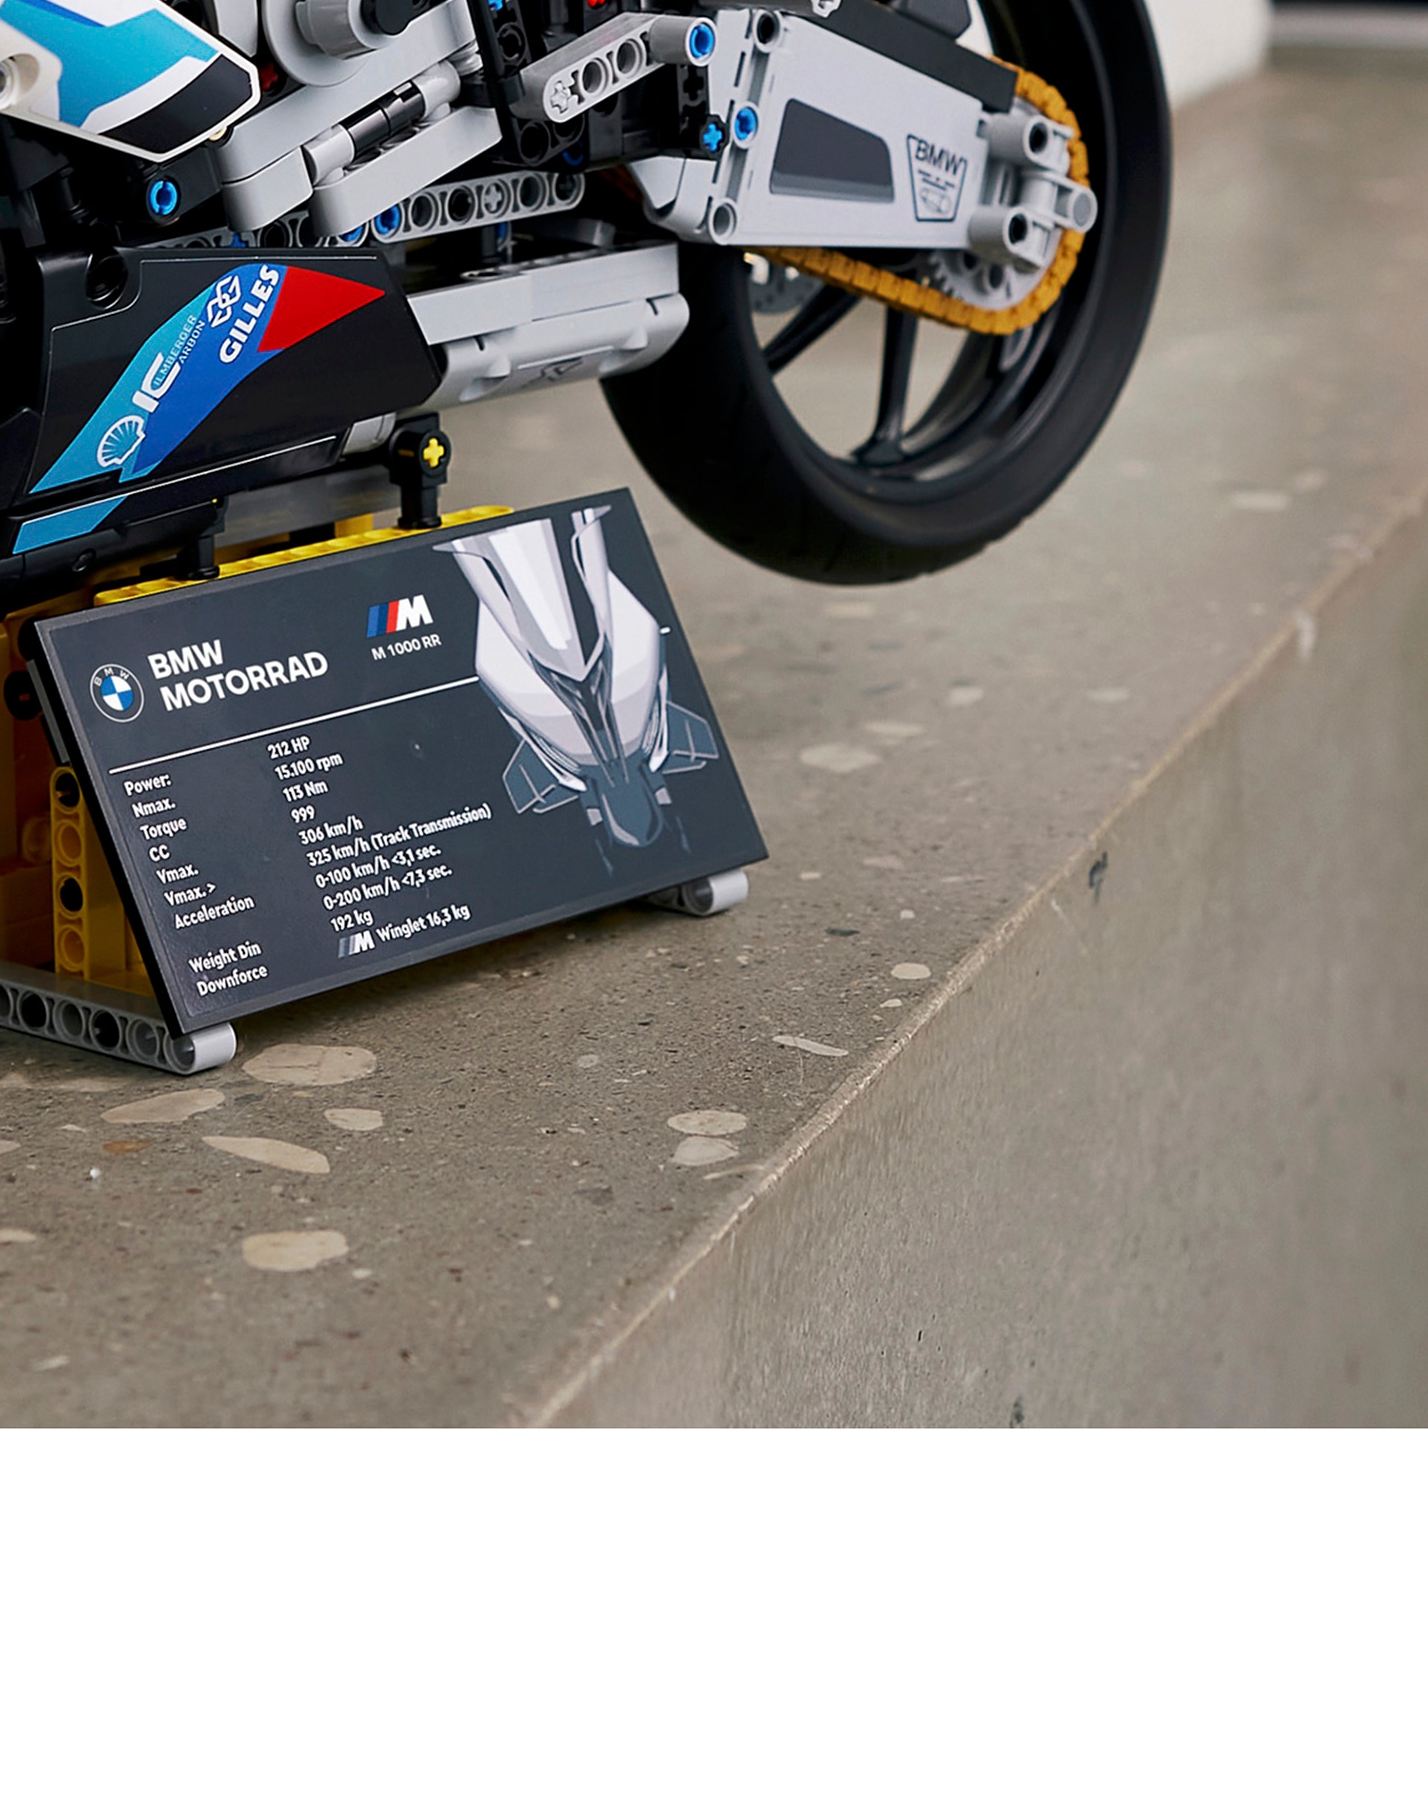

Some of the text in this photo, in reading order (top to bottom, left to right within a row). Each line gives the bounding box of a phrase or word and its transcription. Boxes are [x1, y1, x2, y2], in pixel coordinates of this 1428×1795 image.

[915, 140, 967, 176] BMW
[219, 264, 280, 363] GILLES
[153, 314, 197, 386] ILMBERGER
[147, 639, 225, 680] BMW
[371, 633, 442, 661] M 1000 RR
[159, 651, 329, 713] MOTORRAD
[267, 735, 311, 760] 212 HP
[274, 753, 344, 780] 15.100 rpm
[123, 773, 172, 796] Power:
[282, 779, 329, 802] 113 Nm
[132, 797, 176, 818] Nmax.
[290, 805, 315, 824] 999
[140, 817, 188, 840] Torque
[298, 815, 364, 845] 306 km/h
[306, 802, 493, 867] 325 km/h (Track Transmission)
[148, 844, 171, 862] CC
[315, 867, 352, 889] 0-100
[352, 855, 391, 879] km/h
[415, 843, 442, 860] sec.
[156, 863, 199, 885] Vmax.
[323, 887, 362, 911] 0-200
[362, 876, 401, 901] km/h
[426, 864, 453, 881] sec.
[164, 886, 207, 907] Vmax.
[175, 895, 255, 930] Acceleration
[330, 909, 374, 932] 192 kg
[376, 916, 428, 943] Winglet
[426, 908, 452, 927] 16,3
[450, 903, 471, 922] kg
[188, 941, 262, 974] Weight Din
[196, 965, 269, 997] Downforce
